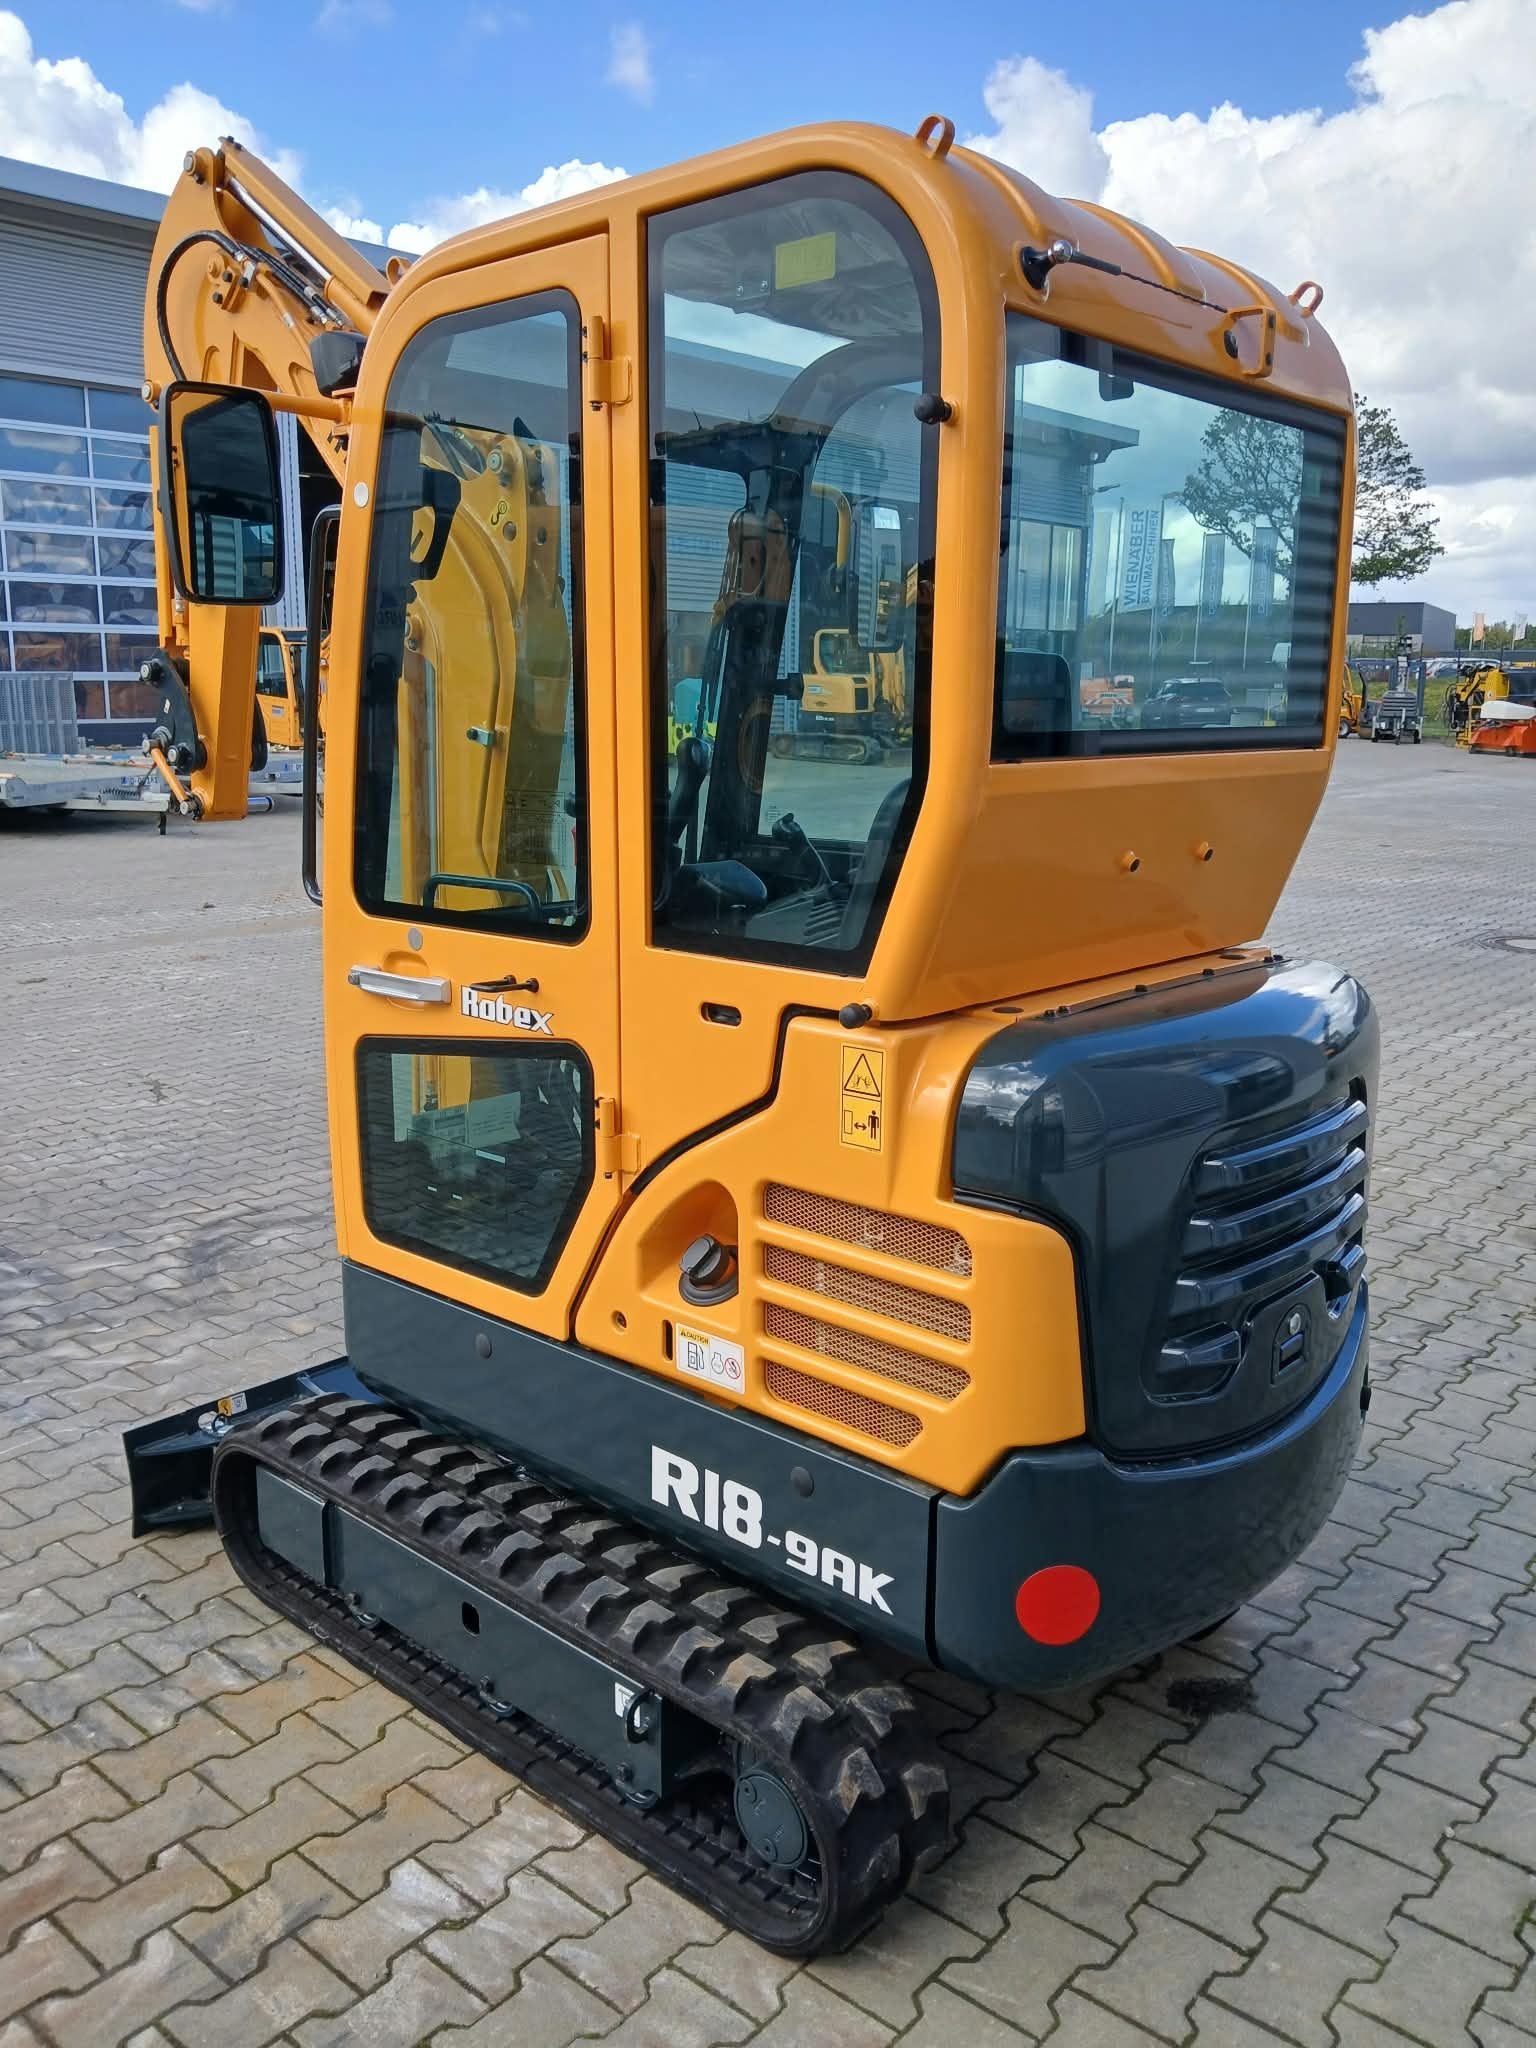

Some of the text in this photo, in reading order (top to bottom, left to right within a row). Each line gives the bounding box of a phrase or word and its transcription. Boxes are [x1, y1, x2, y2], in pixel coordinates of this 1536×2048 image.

[1141, 510, 1160, 604] BAUMASCHINEN
[460, 984, 554, 1036] Robex
[686, 1331, 709, 1344] CAUTION
[651, 1444, 895, 1616] R18-9AK
